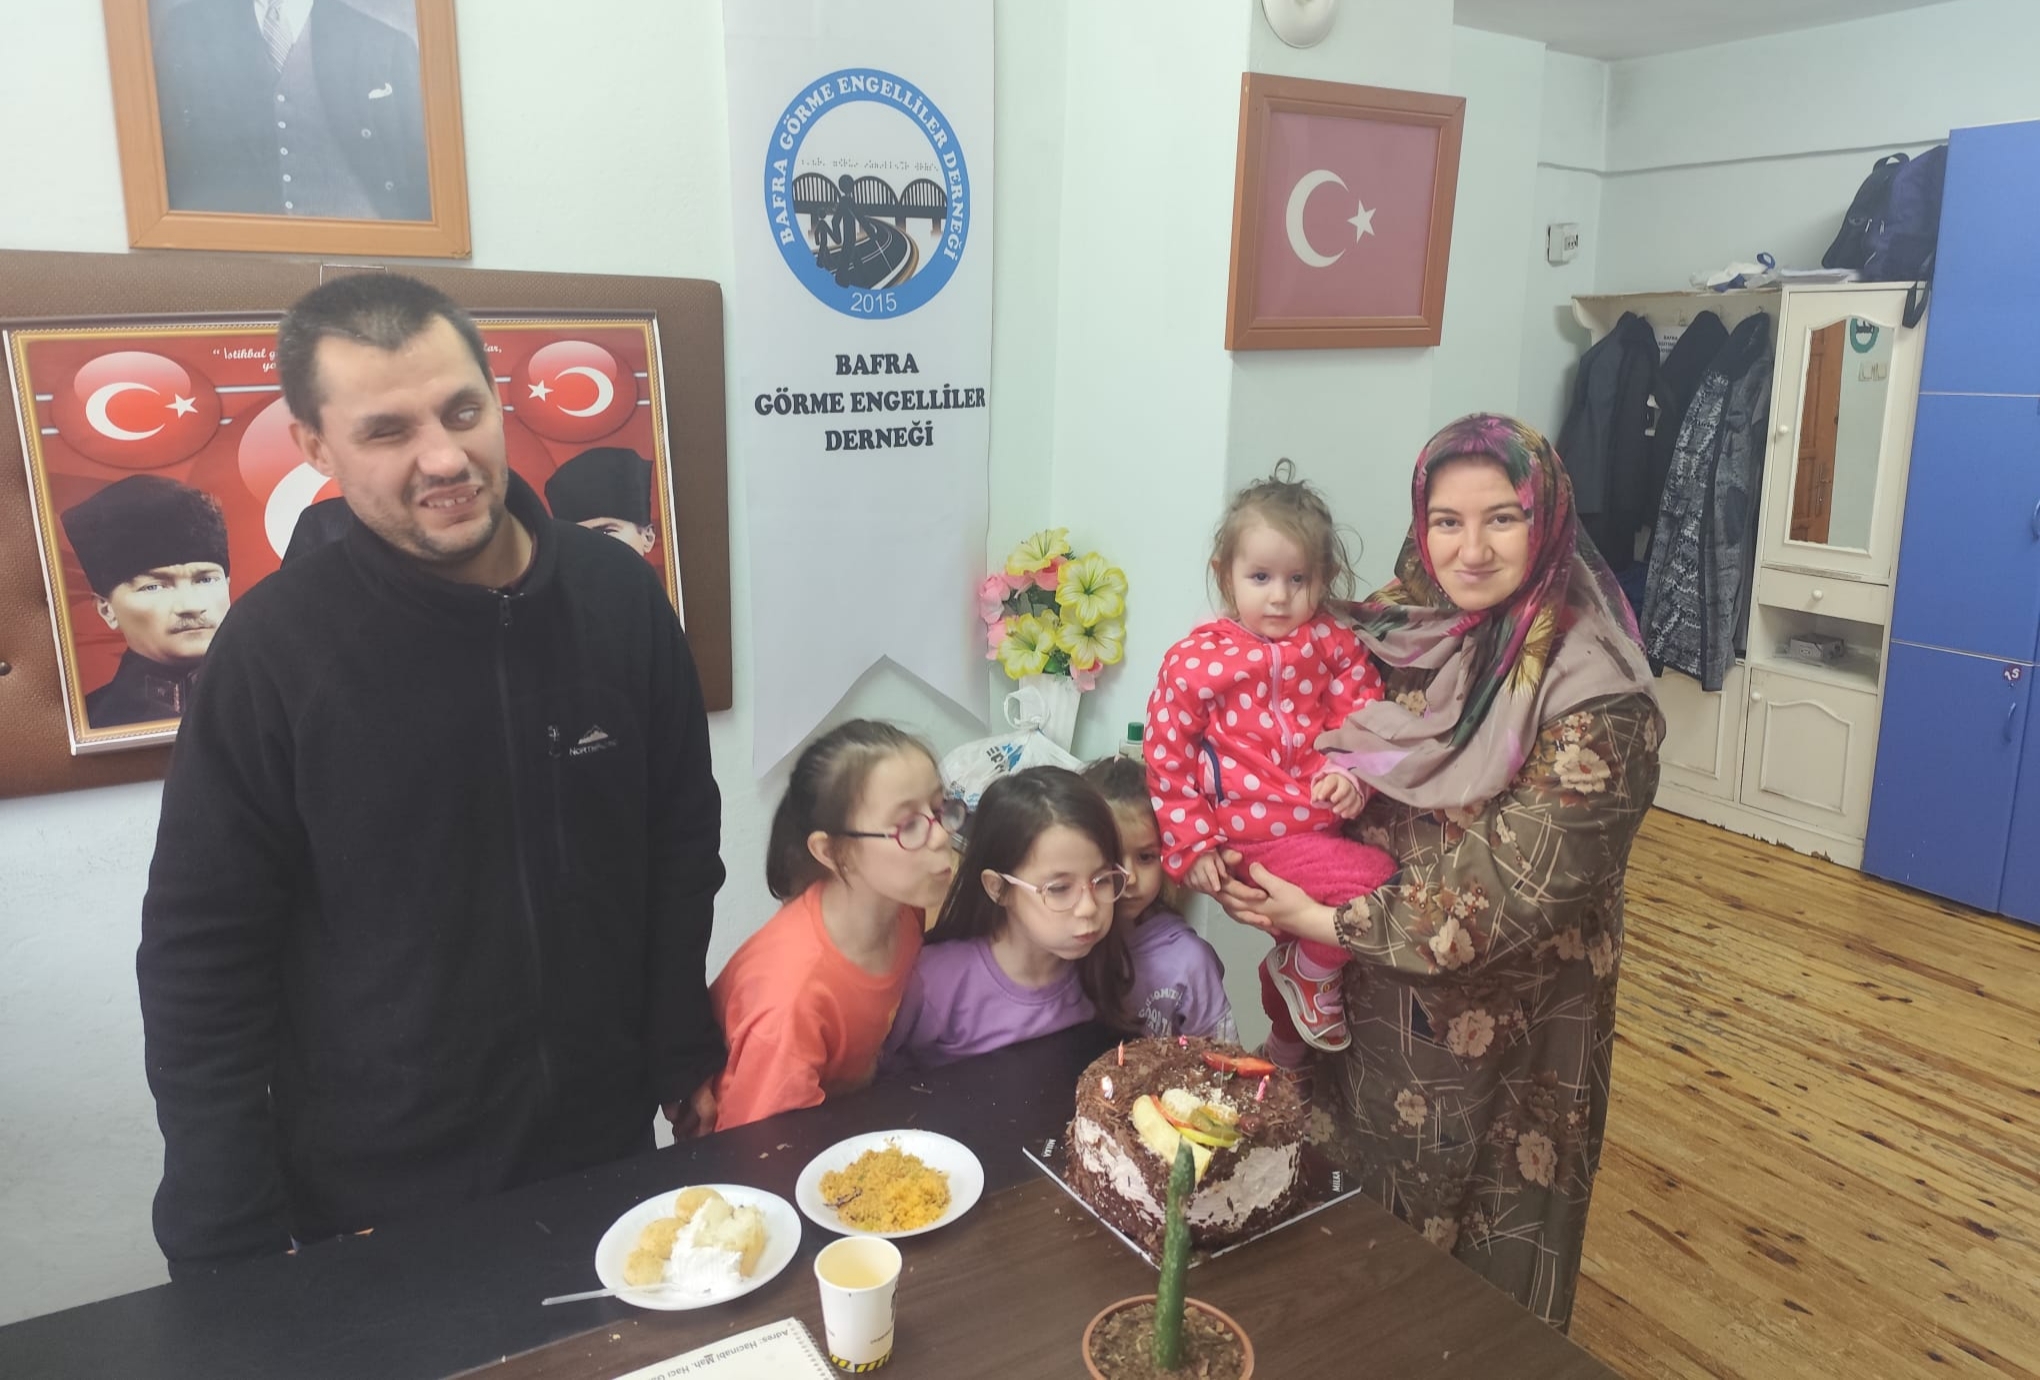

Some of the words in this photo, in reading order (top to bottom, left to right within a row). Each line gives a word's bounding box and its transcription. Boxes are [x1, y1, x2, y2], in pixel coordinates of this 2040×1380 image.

[780, 83, 834, 151] GÖRME
[837, 75, 948, 149] ENGELLİLER
[772, 159, 795, 245] BAFRA
[942, 150, 964, 261] DERNEĞİ
[850, 292, 897, 313] 2015
[835, 352, 919, 376] BAFRA
[754, 386, 845, 416] GÖRME
[850, 382, 986, 413] ENGELLİLER
[825, 419, 934, 451] DERNEĞİ
